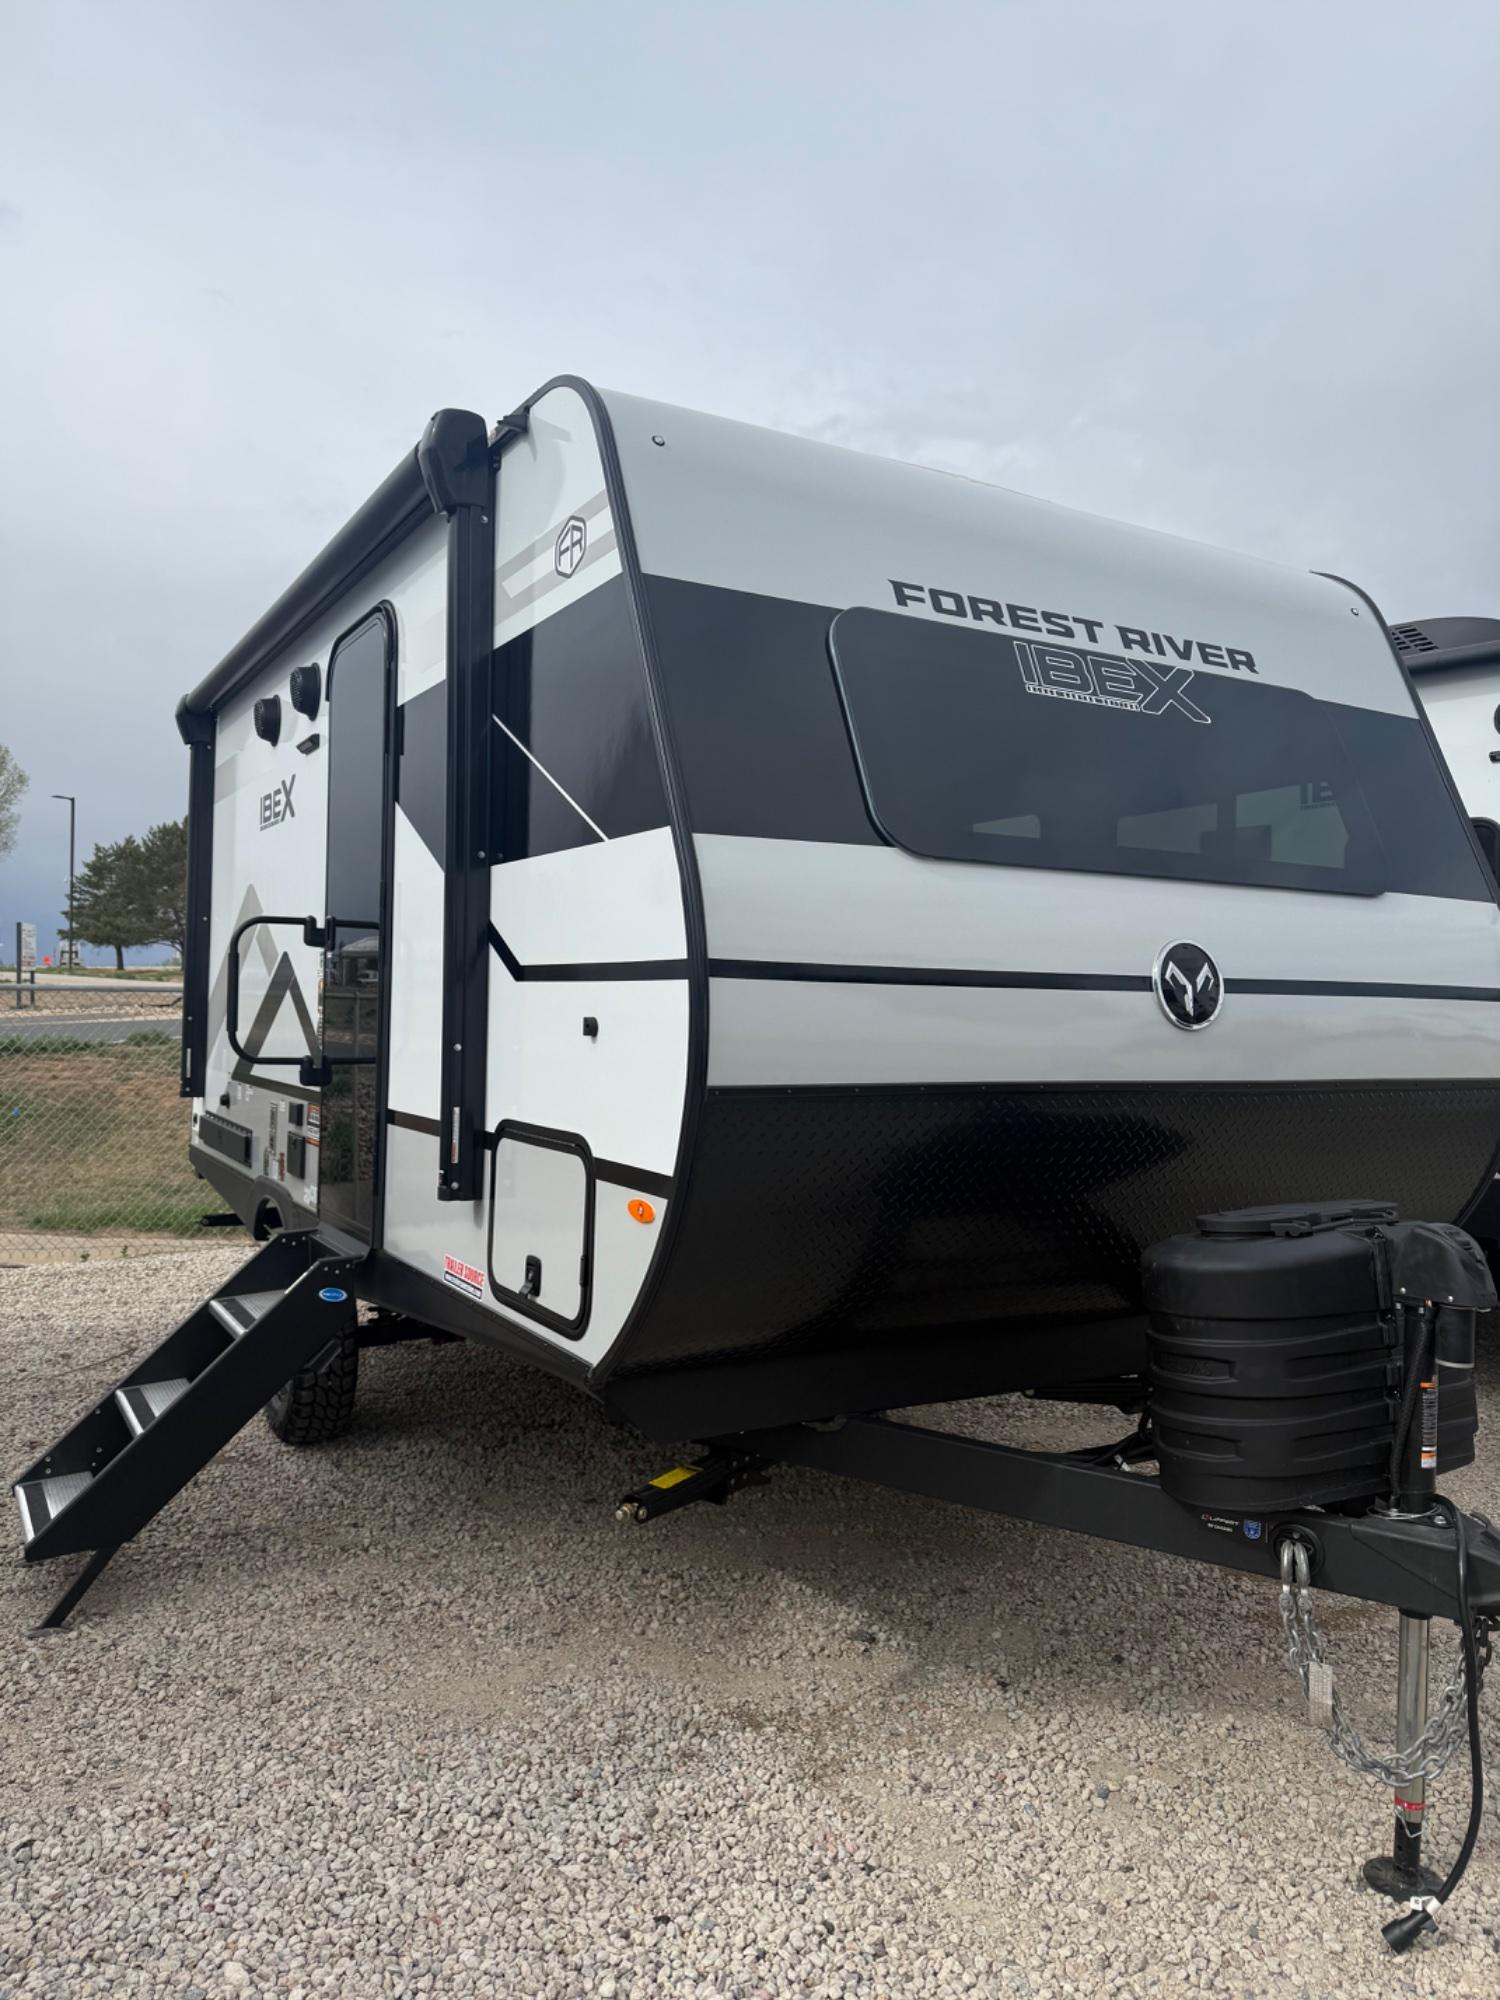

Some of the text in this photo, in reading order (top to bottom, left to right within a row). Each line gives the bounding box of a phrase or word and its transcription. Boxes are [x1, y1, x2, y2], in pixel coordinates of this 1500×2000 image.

[887, 579, 1261, 674] FOREST RIVER
[1013, 641, 1212, 724] IBEX
[260, 774, 296, 825] IBEX
